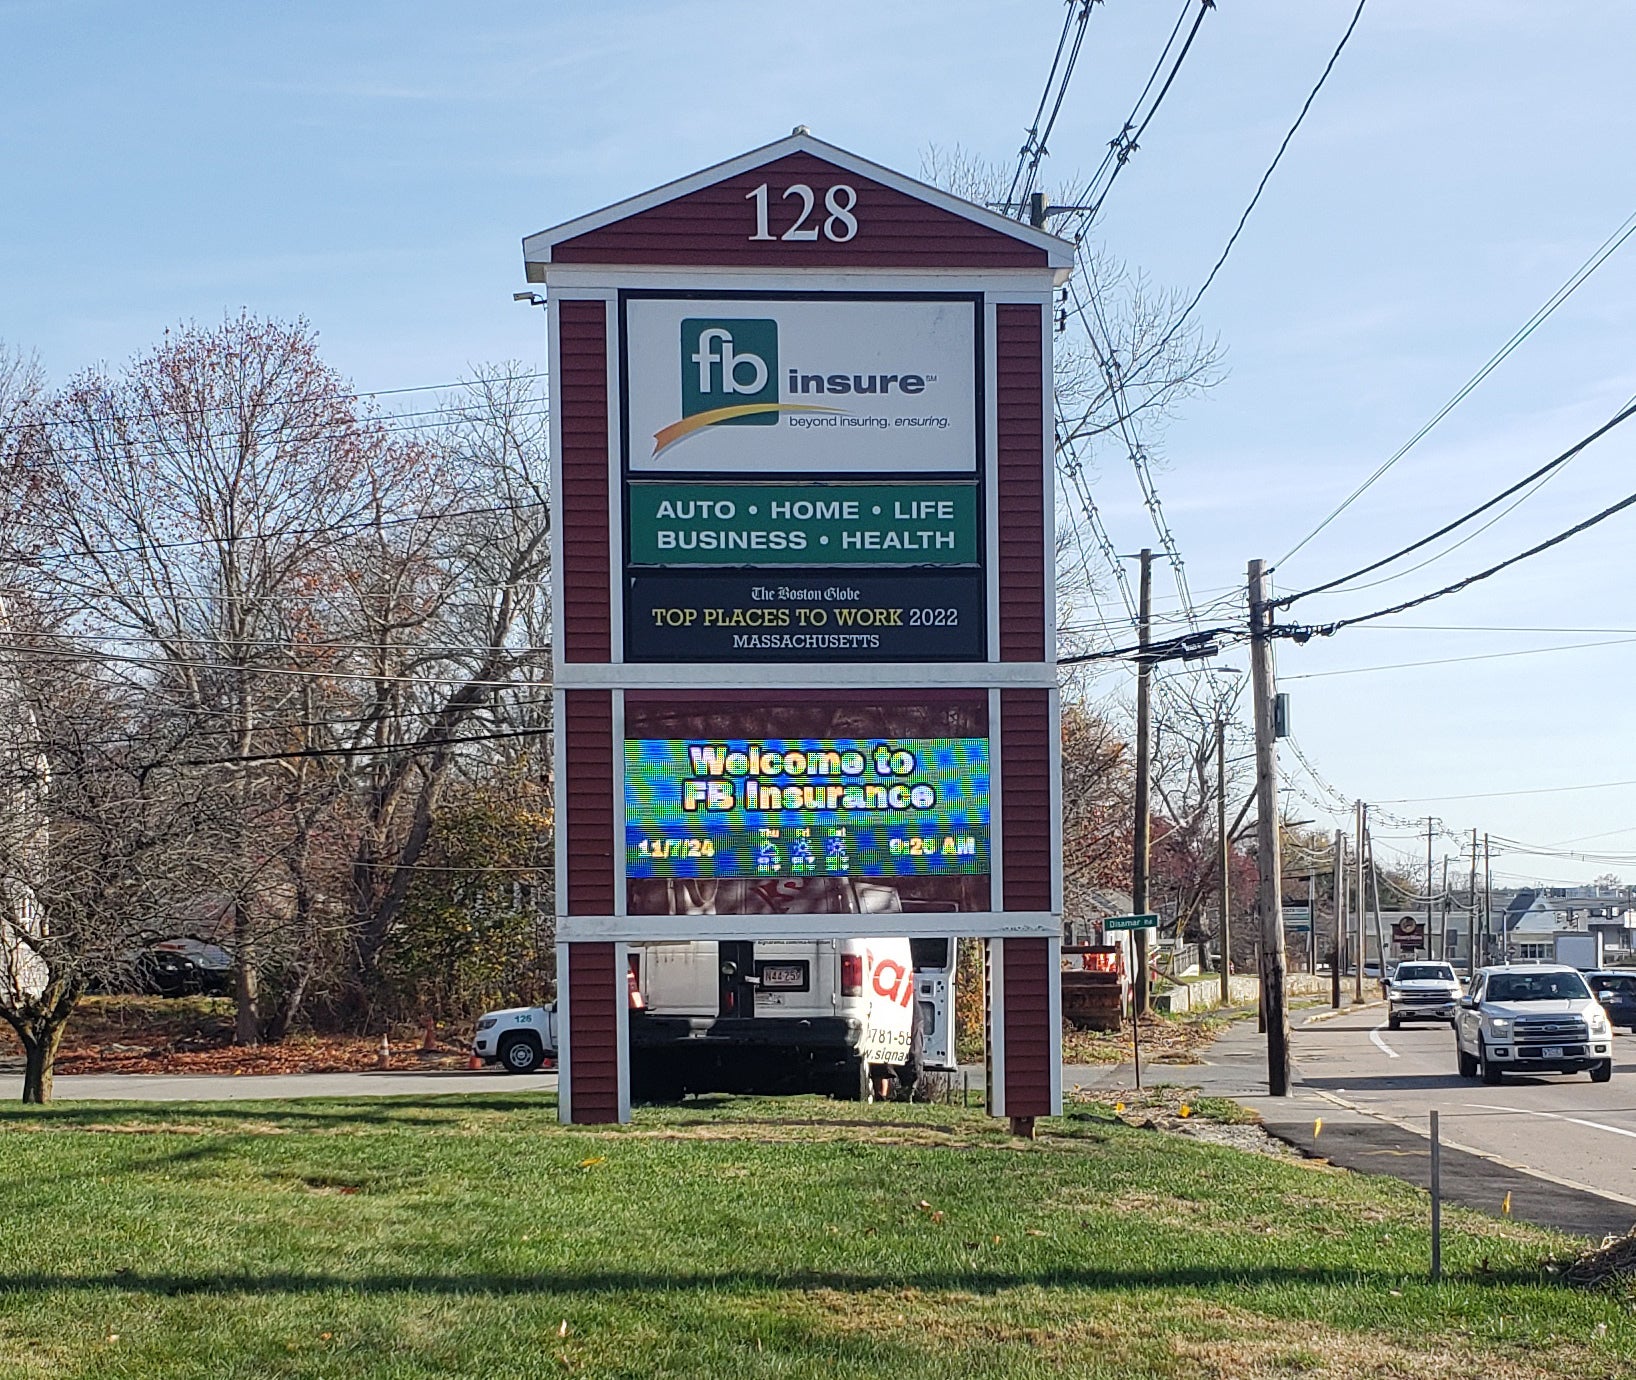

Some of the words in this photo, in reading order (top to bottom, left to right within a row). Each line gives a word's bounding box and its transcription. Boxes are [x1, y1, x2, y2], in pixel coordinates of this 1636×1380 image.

[745, 183, 859, 242] 128
[692, 327, 769, 395] fb
[789, 368, 925, 395] insure
[789, 415, 837, 429] beyond
[839, 415, 891, 429] insuring.
[894, 415, 951, 429] ensuring.
[656, 500, 736, 519] AUTO
[771, 501, 860, 519] HOME
[894, 501, 954, 519] LIFE
[657, 531, 807, 550] BUSINESS
[842, 531, 956, 550] HEALTH
[751, 587, 775, 601] The
[777, 586, 822, 601] Boston
[823, 586, 861, 601] Globe
[652, 609, 698, 626] TOP
[703, 609, 790, 626] PLACES
[796, 609, 828, 626] TO
[833, 608, 904, 626] WORK
[909, 608, 958, 626] 2022
[733, 634, 880, 649] MASSACHUSETTS
[689, 745, 864, 776] Welcome
[873, 745, 916, 776] to
[683, 780, 735, 811] FB
[745, 779, 935, 811] Insurance
[941, 834, 976, 856] AM
